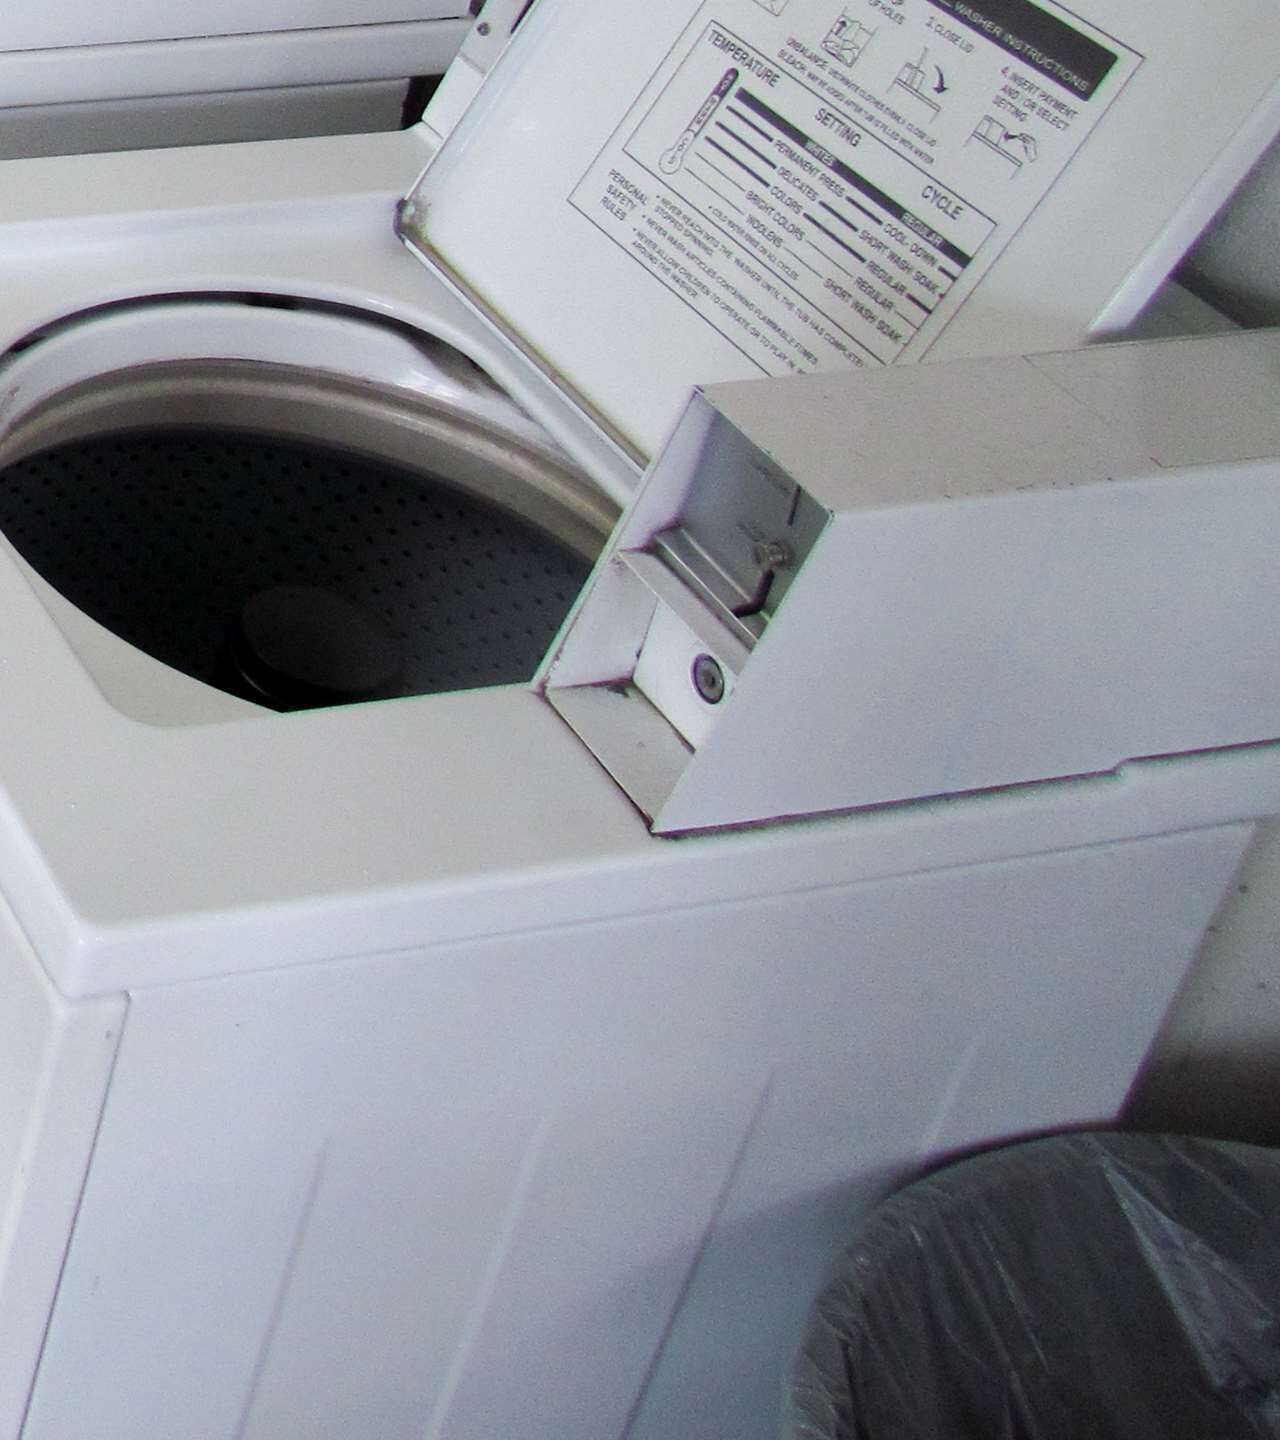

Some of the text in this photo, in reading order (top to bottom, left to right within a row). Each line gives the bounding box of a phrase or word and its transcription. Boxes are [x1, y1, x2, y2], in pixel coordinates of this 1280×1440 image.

[877, 3, 905, 25] HOLES
[933, 21, 962, 45] CLOSE
[958, 38, 975, 53] LID
[951, 0, 1089, 92] WASHER INSTRUCTIONS
[706, 29, 780, 88] TEMPERATURE
[991, 94, 1028, 122] SETTING
[999, 82, 1020, 101] AND
[1035, 106, 1069, 132] SELECT
[1008, 71, 1041, 96] INSERT
[1038, 90, 1078, 120] PAYMENT
[813, 107, 862, 148] SETTING
[607, 168, 649, 206] PERSONAL
[772, 139, 846, 198] PERMANENT PRESS
[775, 165, 819, 202] DELICATES
[598, 195, 627, 222] RULES
[604, 183, 636, 212] SAFETY
[744, 189, 806, 241] BRIGHT COLORS
[769, 184, 803, 215] COLORS
[919, 183, 963, 221] CYCLE
[653, 205, 684, 232] STOPPED
[744, 213, 784, 248] WOOLENS
[900, 211, 944, 247] REGULAR
[630, 239, 658, 265] AROUND
[656, 261, 671, 276] THE
[659, 196, 682, 218] NEVER
[680, 213, 705, 236] REACH
[718, 244, 732, 259] THE
[732, 256, 761, 283] WASHER
[780, 295, 794, 310] THE
[794, 307, 810, 323] TUB
[808, 318, 825, 335] HAS
[857, 228, 889, 256] SHORT
[912, 269, 940, 294] SOAK
[908, 242, 938, 268] DOWN
[635, 229, 658, 251] NEVER
[655, 247, 680, 270] ALLOW
[677, 265, 711, 297] CHILDREN
[709, 292, 721, 305] TO
[719, 301, 750, 329] OPERATE
[748, 325, 761, 339] OR
[759, 334, 771, 347] TO
[768, 342, 789, 362] PLAY
[645, 216, 668, 238] NEVER
[684, 249, 717, 279] ARTICLES
[715, 275, 755, 311] CONTAINING
[753, 307, 796, 345] FLAMMABLE
[852, 275, 894, 312] REGULAR
[864, 259, 907, 296] REGULAR
[822, 276, 852, 304] SHORT
[875, 318, 902, 344] SOAK
